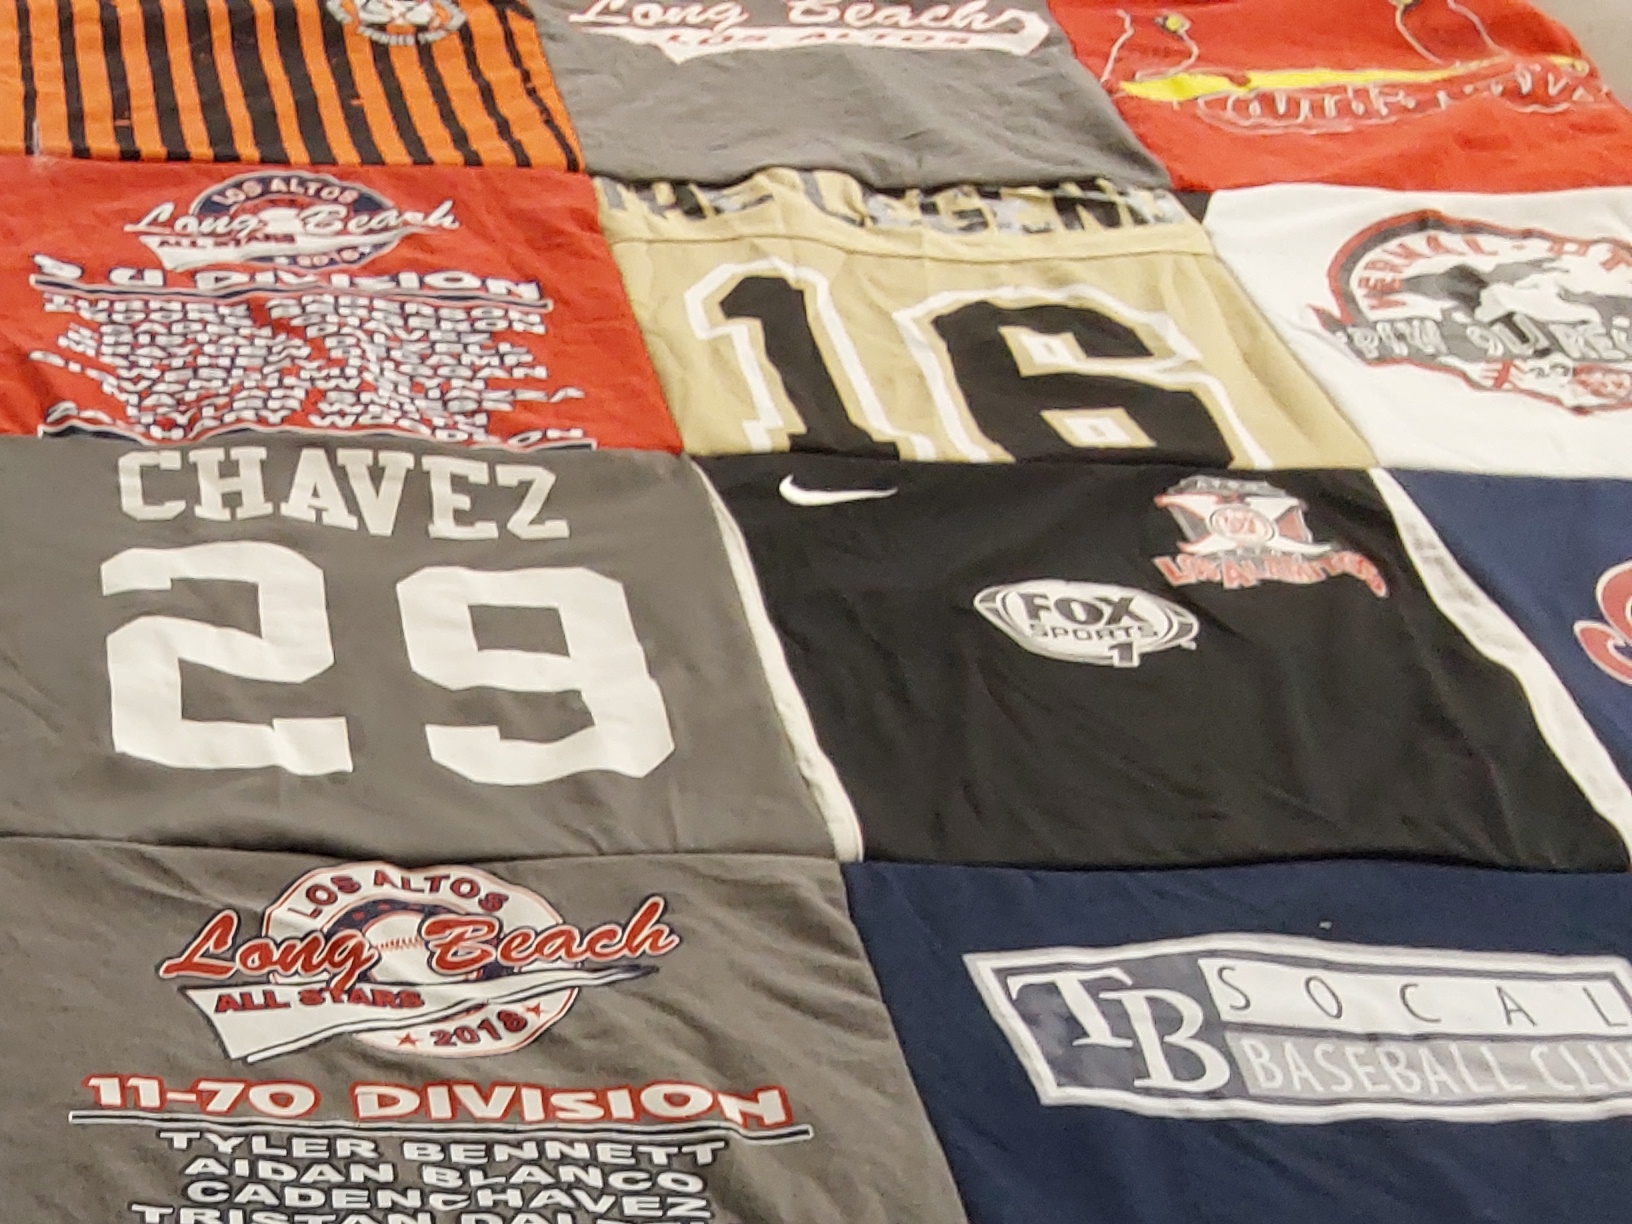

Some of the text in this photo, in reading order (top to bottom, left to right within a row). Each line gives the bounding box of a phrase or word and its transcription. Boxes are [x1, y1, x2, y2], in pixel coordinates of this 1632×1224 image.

[269, 176, 360, 204] ALTOS
[123, 199, 461, 240] Long Beach
[116, 446, 570, 540] CHAVEZ
[1015, 592, 1150, 627] FOX
[1029, 622, 1159, 643] SPORTS
[99, 540, 676, 787] 29
[285, 870, 510, 919] LOS ALTOS
[159, 895, 680, 992] Long Beach
[213, 987, 426, 1015] ALL STARS
[428, 1010, 529, 1049] 2018
[1006, 966, 1231, 1093] TB
[1246, 1031, 1523, 1096] BASEBALL
[82, 1074, 796, 1128] 11-70 DIVISION
[159, 1130, 727, 1166] TYLER BENNETT
[183, 1156, 706, 1194] AIDAN BLANCO
[186, 1179, 714, 1218] CADEN CHAVEZ
